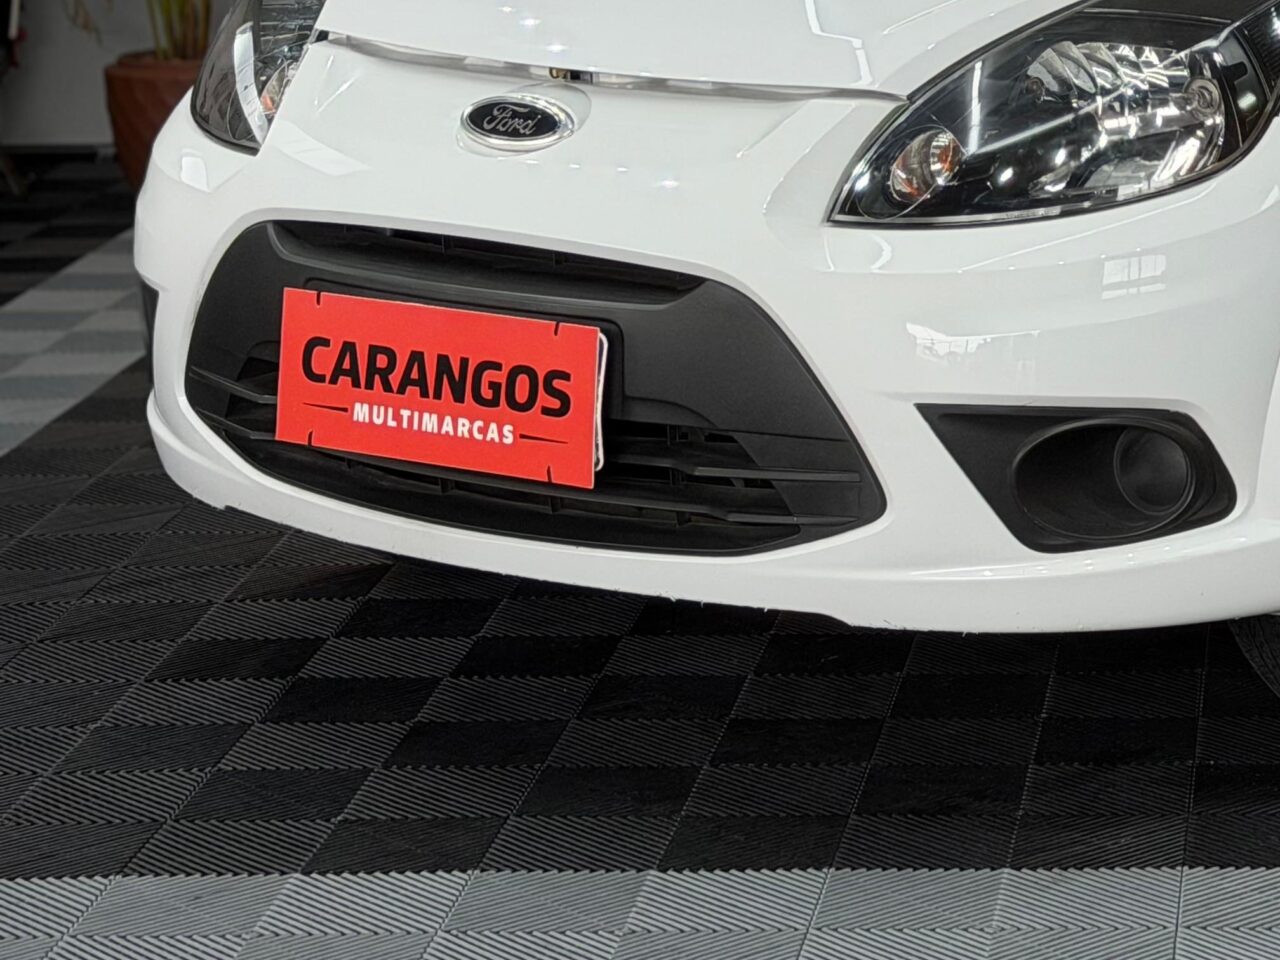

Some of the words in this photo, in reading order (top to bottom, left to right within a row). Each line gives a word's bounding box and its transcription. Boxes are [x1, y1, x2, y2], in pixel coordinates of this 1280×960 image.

[483, 103, 541, 135] Ford
[302, 336, 571, 418] CARANGOS
[353, 402, 514, 445] MULTIMARCAS
